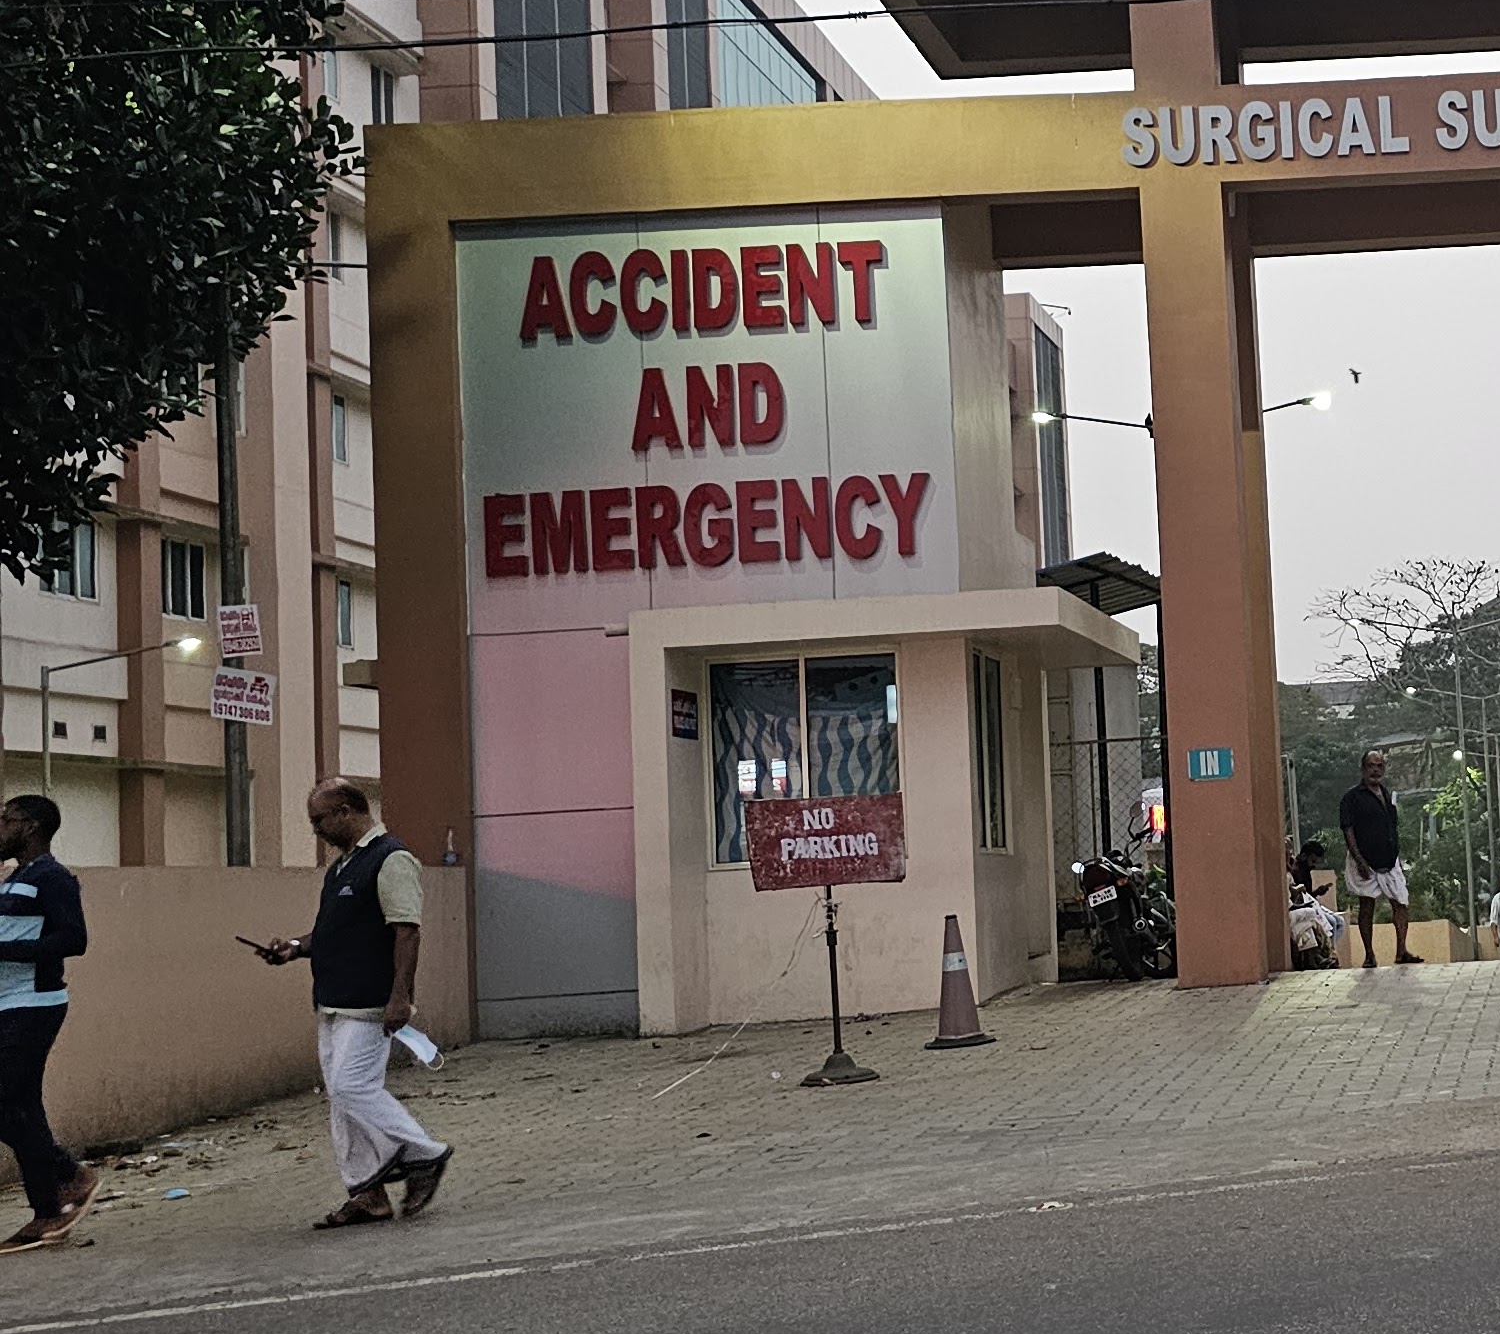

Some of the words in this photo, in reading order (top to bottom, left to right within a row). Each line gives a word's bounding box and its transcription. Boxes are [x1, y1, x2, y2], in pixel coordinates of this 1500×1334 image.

[1122, 95, 1410, 167] SURGICAL
[519, 240, 888, 346] ACCIDENT
[632, 362, 785, 451] AND
[483, 473, 931, 578] EMERGENCY
[1199, 750, 1220, 776] IN
[780, 832, 879, 861] PARKING
[802, 808, 835, 830] NO
